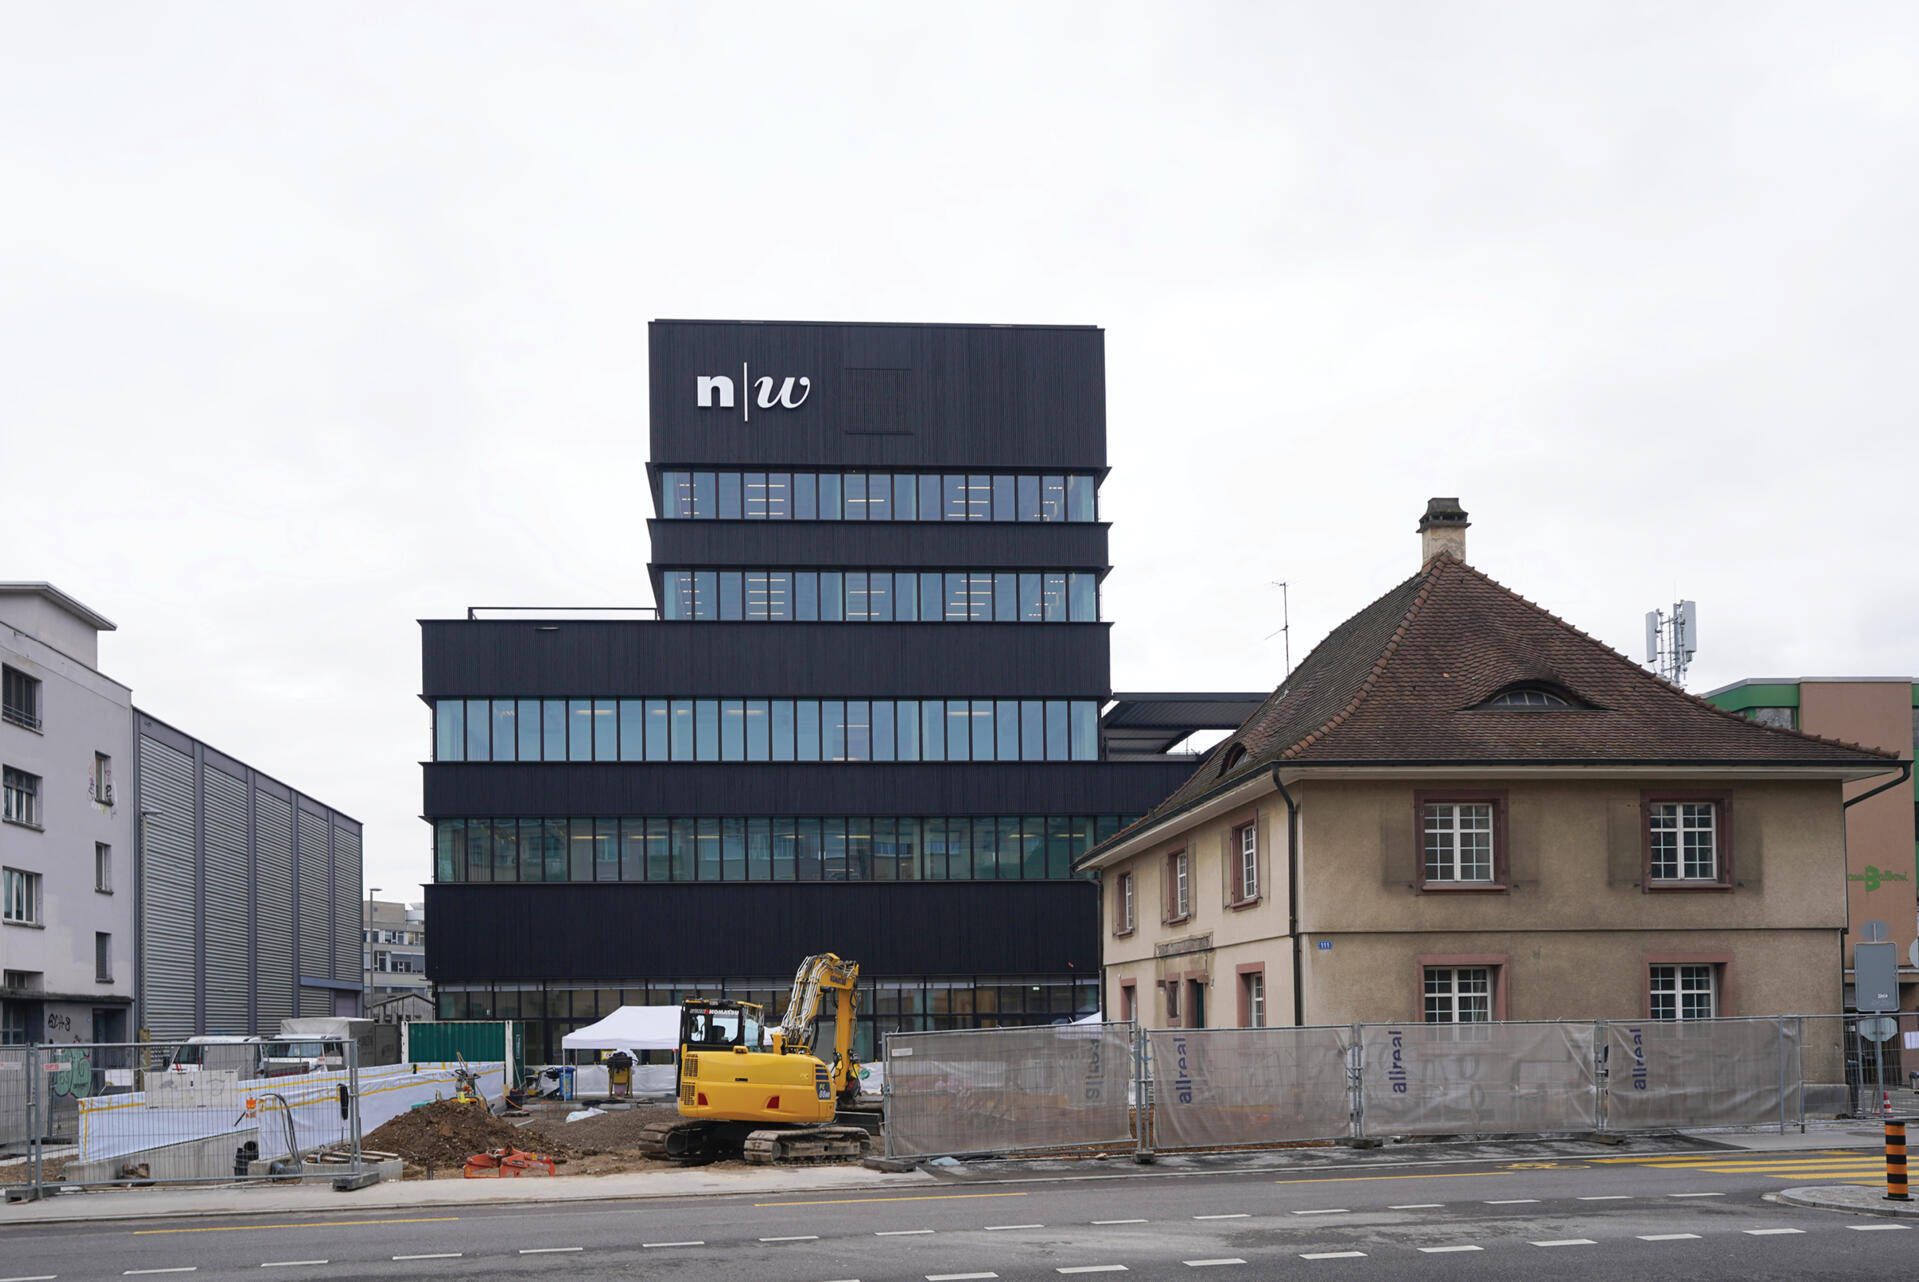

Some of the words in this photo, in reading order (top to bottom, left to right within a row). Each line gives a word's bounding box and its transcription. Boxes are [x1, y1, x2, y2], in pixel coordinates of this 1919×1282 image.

[1173, 1037, 1192, 1104] allreal
[1388, 1031, 1407, 1094] allreal
[1629, 1028, 1647, 1090] allreal
